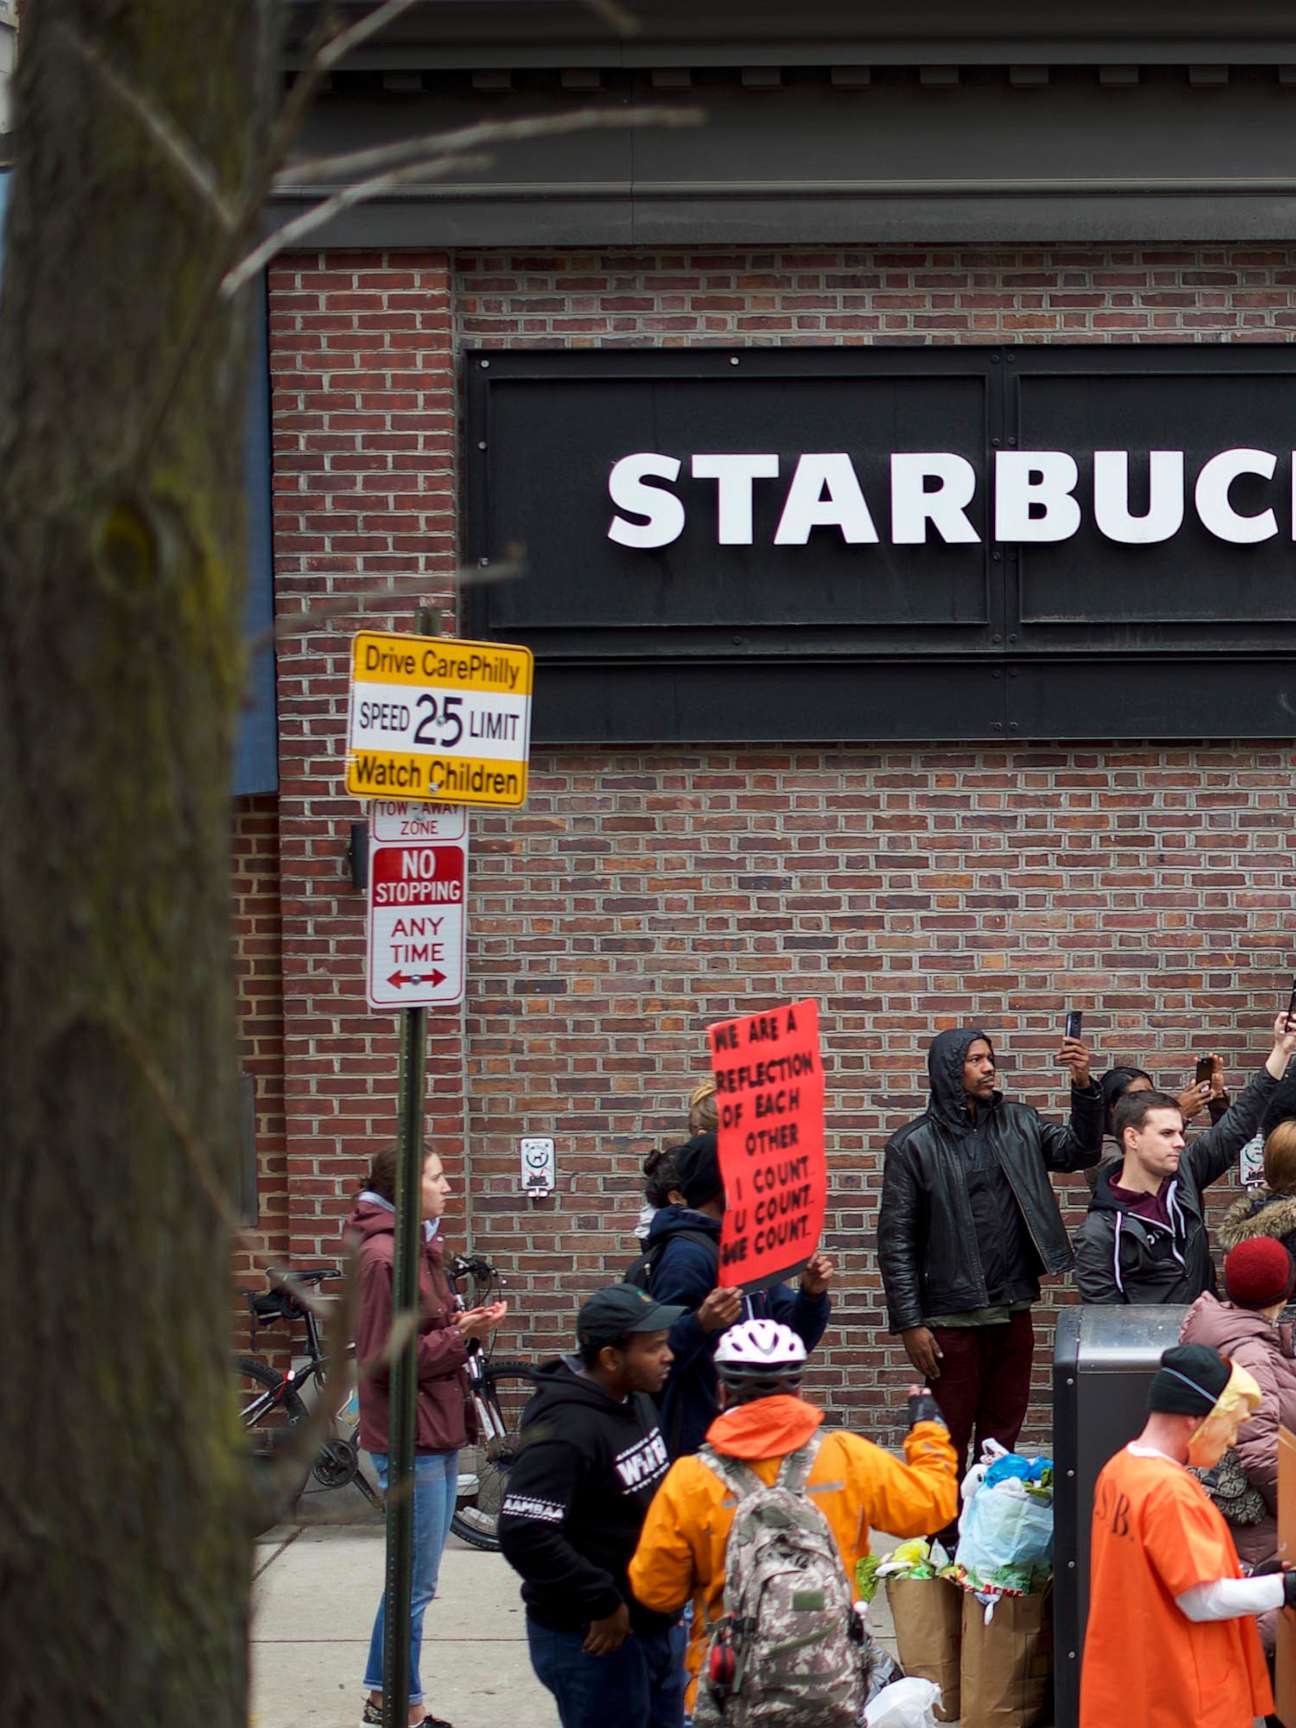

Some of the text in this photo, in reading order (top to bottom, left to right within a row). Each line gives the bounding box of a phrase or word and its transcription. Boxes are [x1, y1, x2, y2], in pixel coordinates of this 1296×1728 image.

[366, 644, 520, 689] Drive CarePhilly
[359, 693, 520, 748] SPEED 25 LIMIT
[355, 755, 518, 795] Watch Children
[400, 819, 438, 836] ZONE
[401, 849, 436, 880] NO
[375, 880, 461, 903] STOPPING
[391, 917, 445, 937] ANY
[390, 943, 445, 963] TIME
[748, 1016, 779, 1044] ARE
[786, 1007, 798, 1032] A
[716, 1053, 814, 1093] REFLECTION
[722, 1088, 800, 1129] OF EACH
[745, 1124, 798, 1156] OTHER
[736, 1176, 742, 1200] I
[733, 1209, 748, 1233] U
